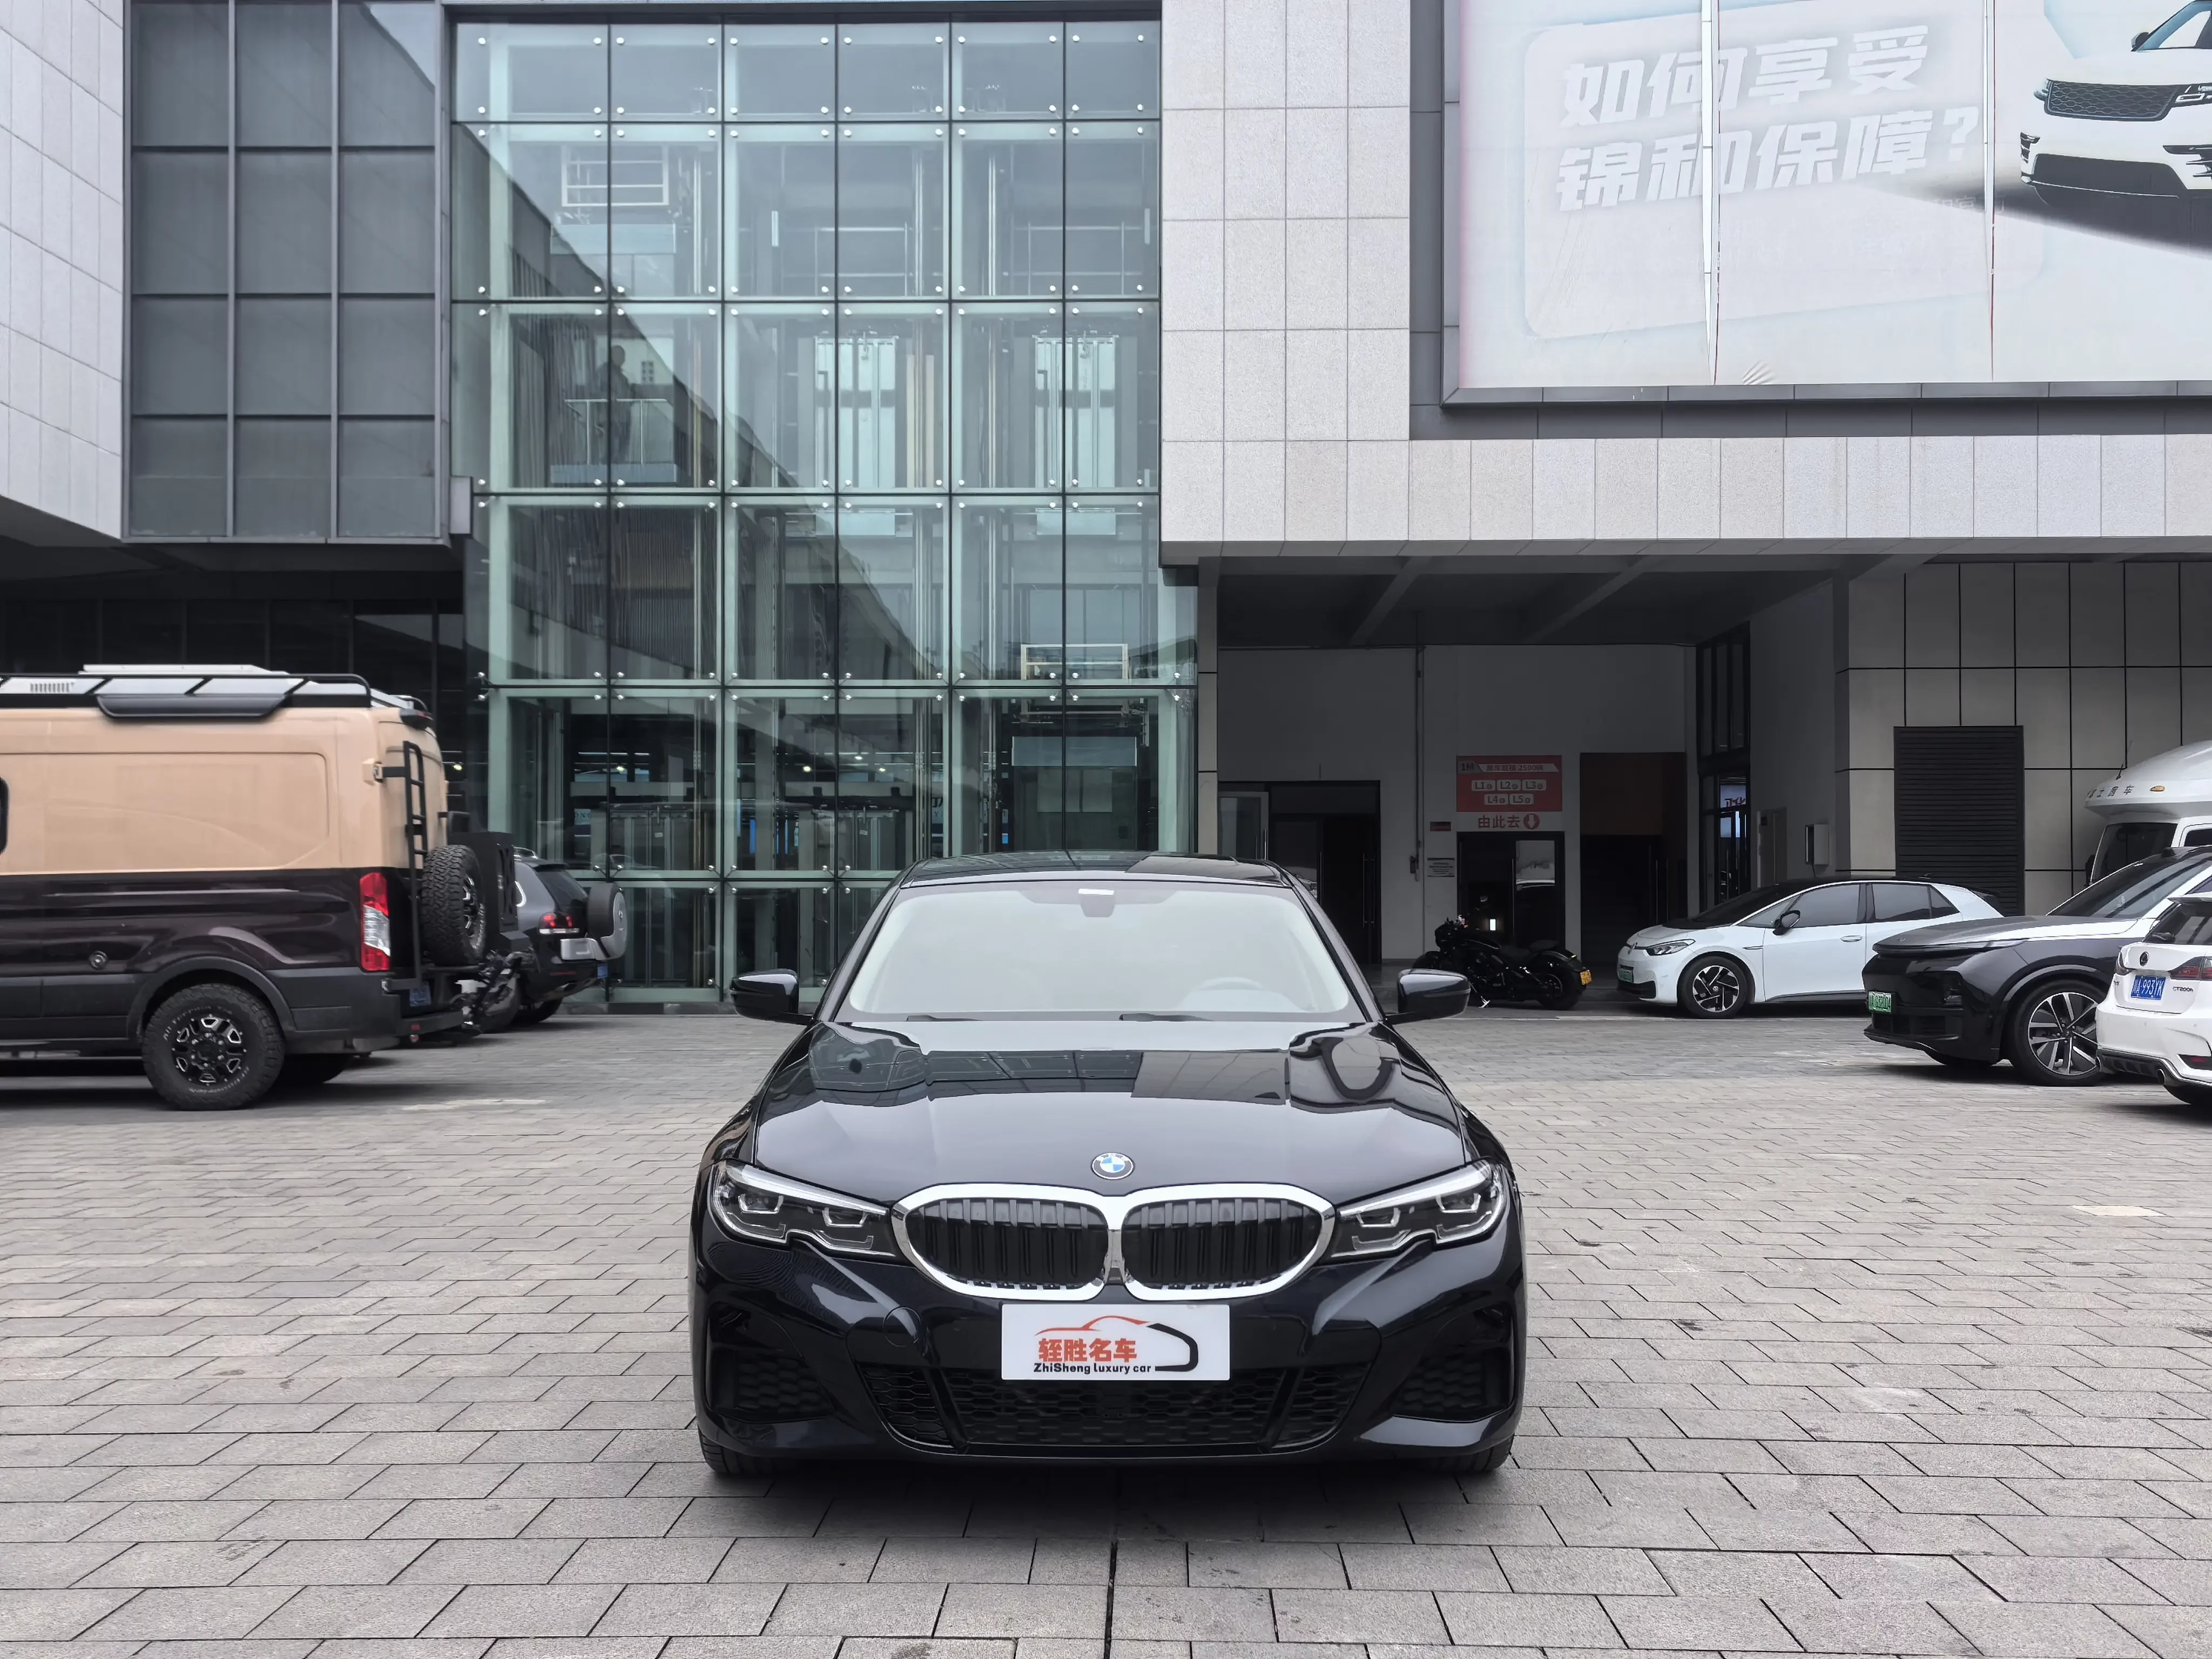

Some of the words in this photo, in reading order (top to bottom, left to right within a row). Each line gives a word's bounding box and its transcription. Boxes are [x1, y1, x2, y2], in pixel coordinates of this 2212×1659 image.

[1560, 25, 1928, 126] 如何享受
[1478, 814, 1520, 828] 由此去
[1034, 1363, 1090, 1374] ZhiSheng
[1093, 1363, 1130, 1374] luxury
